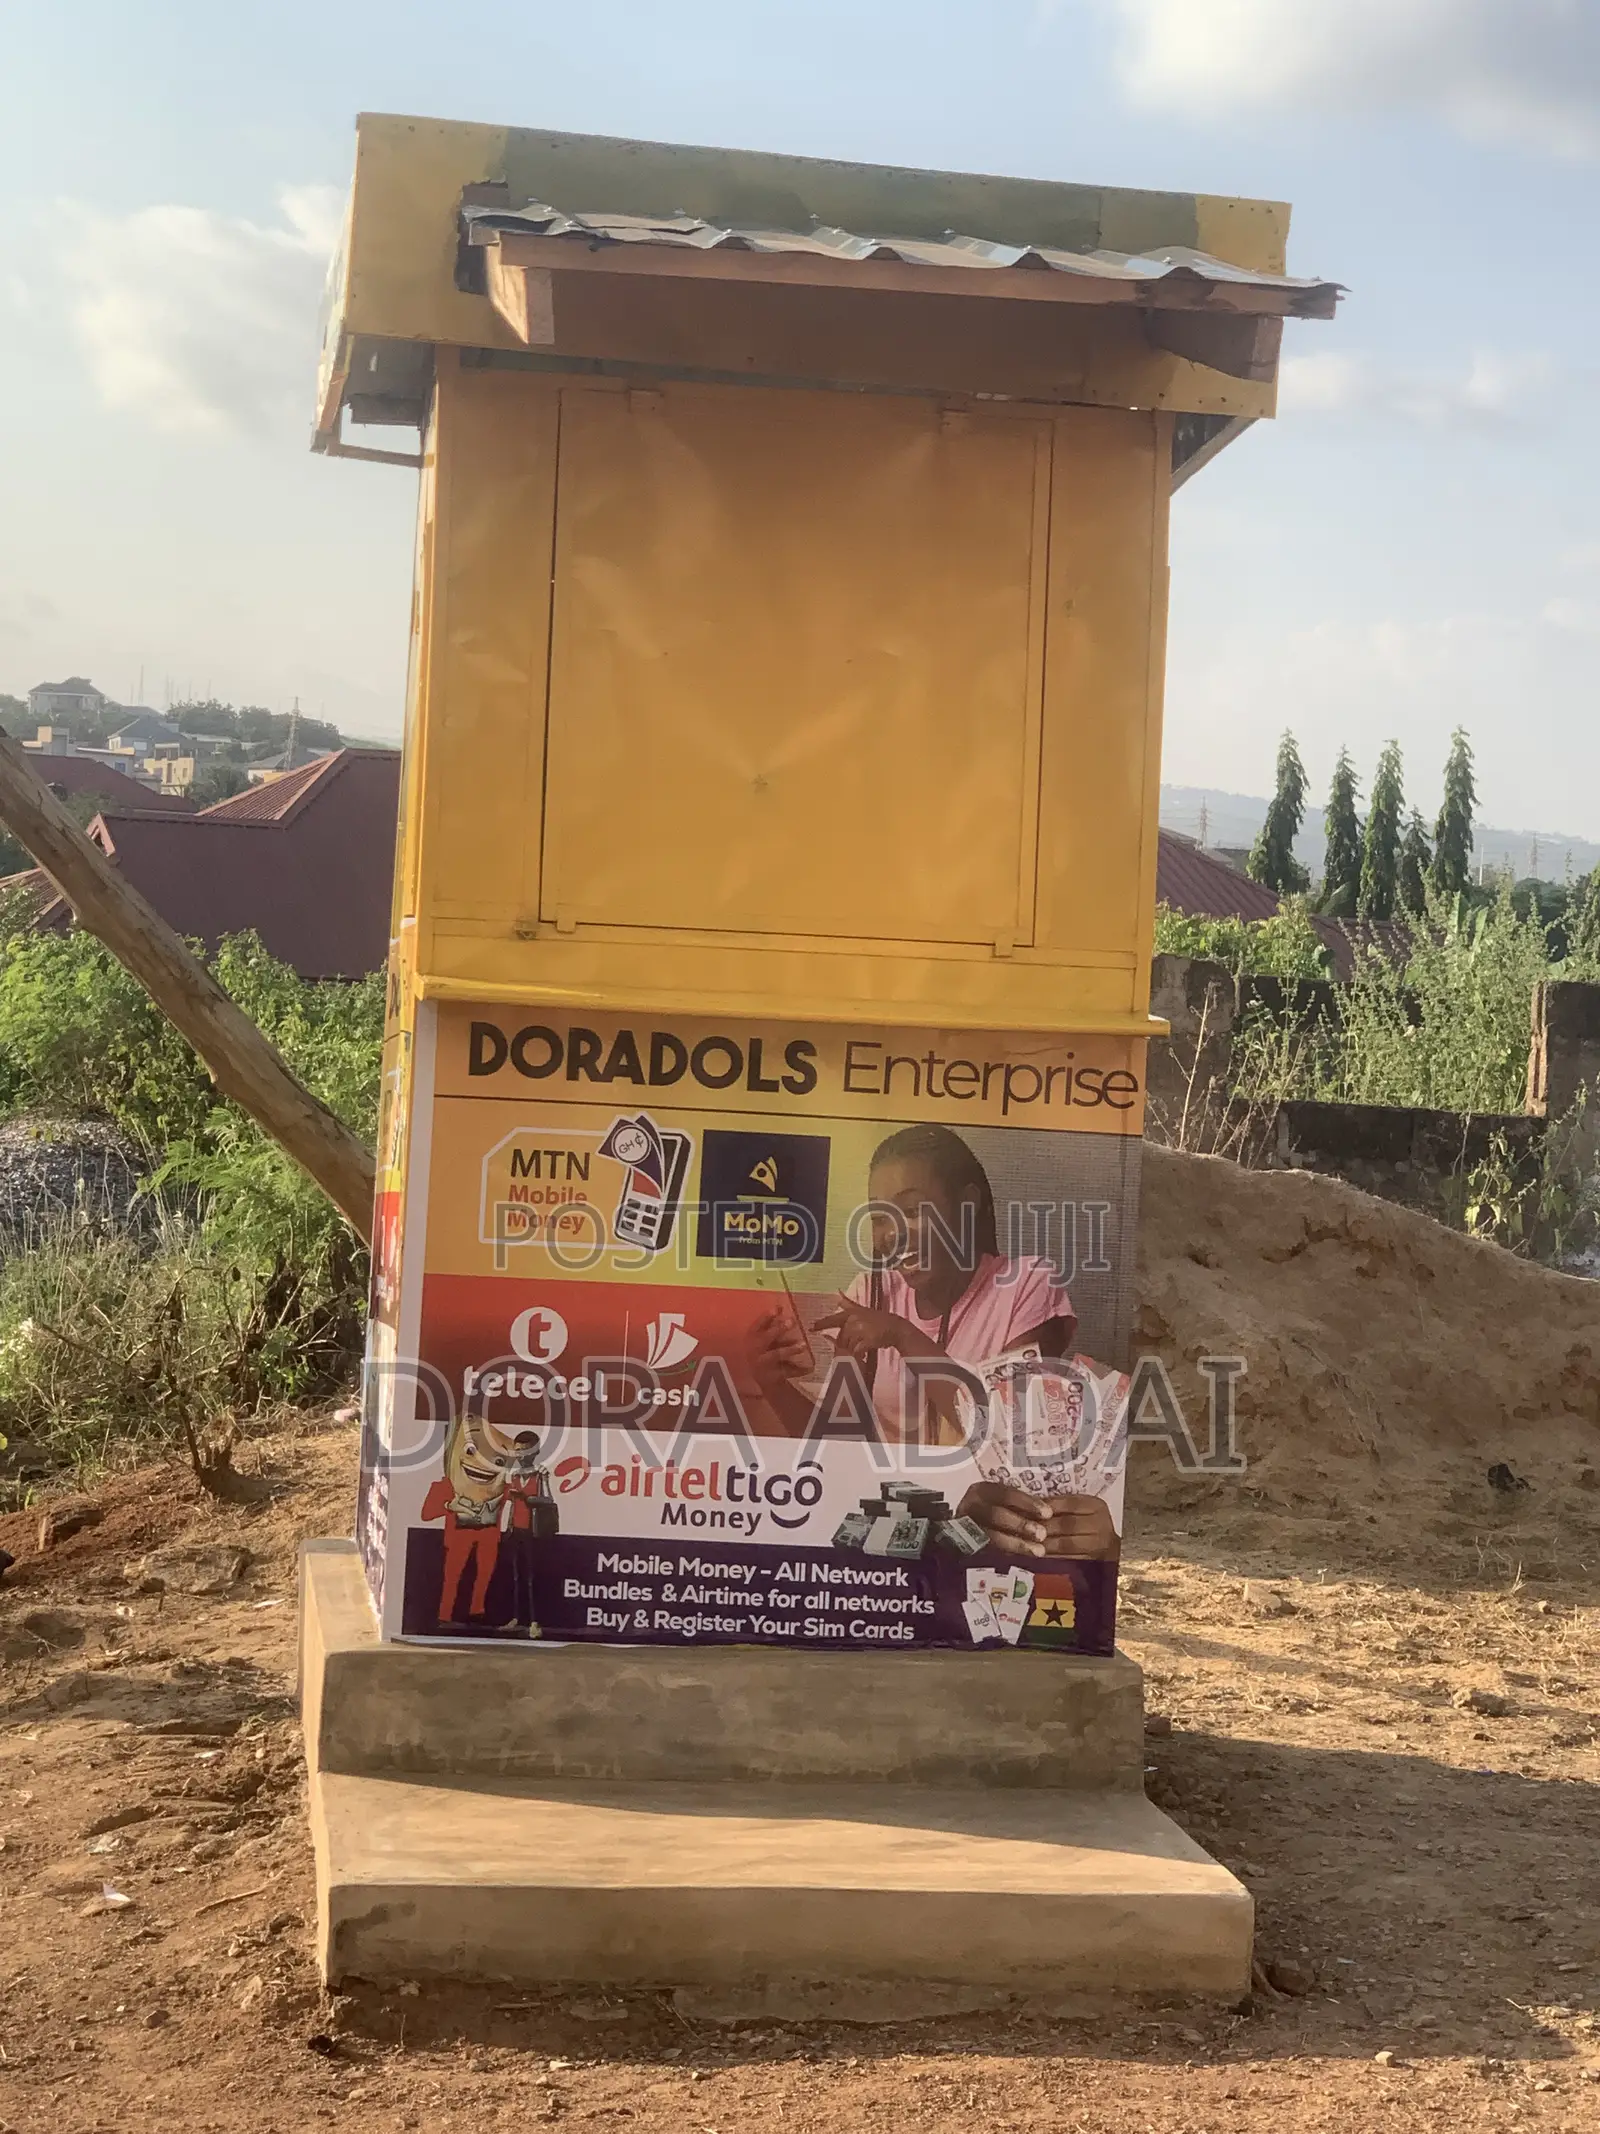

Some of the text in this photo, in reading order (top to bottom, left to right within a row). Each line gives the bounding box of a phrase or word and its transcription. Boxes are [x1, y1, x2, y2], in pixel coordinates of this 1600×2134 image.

[468, 1021, 1139, 1116] DORADOLS Enterprise
[510, 1148, 591, 1181] MTN
[508, 1184, 588, 1207] Mobile
[507, 1207, 586, 1235] Money
[724, 1211, 799, 1236] MoMo
[463, 1365, 609, 1403] telecel
[636, 1384, 700, 1407] cash
[659, 1502, 763, 1537] Money
[596, 1552, 675, 1577] Mobile
[678, 1556, 757, 1584] Money
[774, 1561, 807, 1583] All
[811, 1562, 909, 1587] Network
[563, 1578, 936, 1615] Bundles & Airtime for all networks
[586, 1606, 916, 1641] Buy & Register Your Sim Cards
